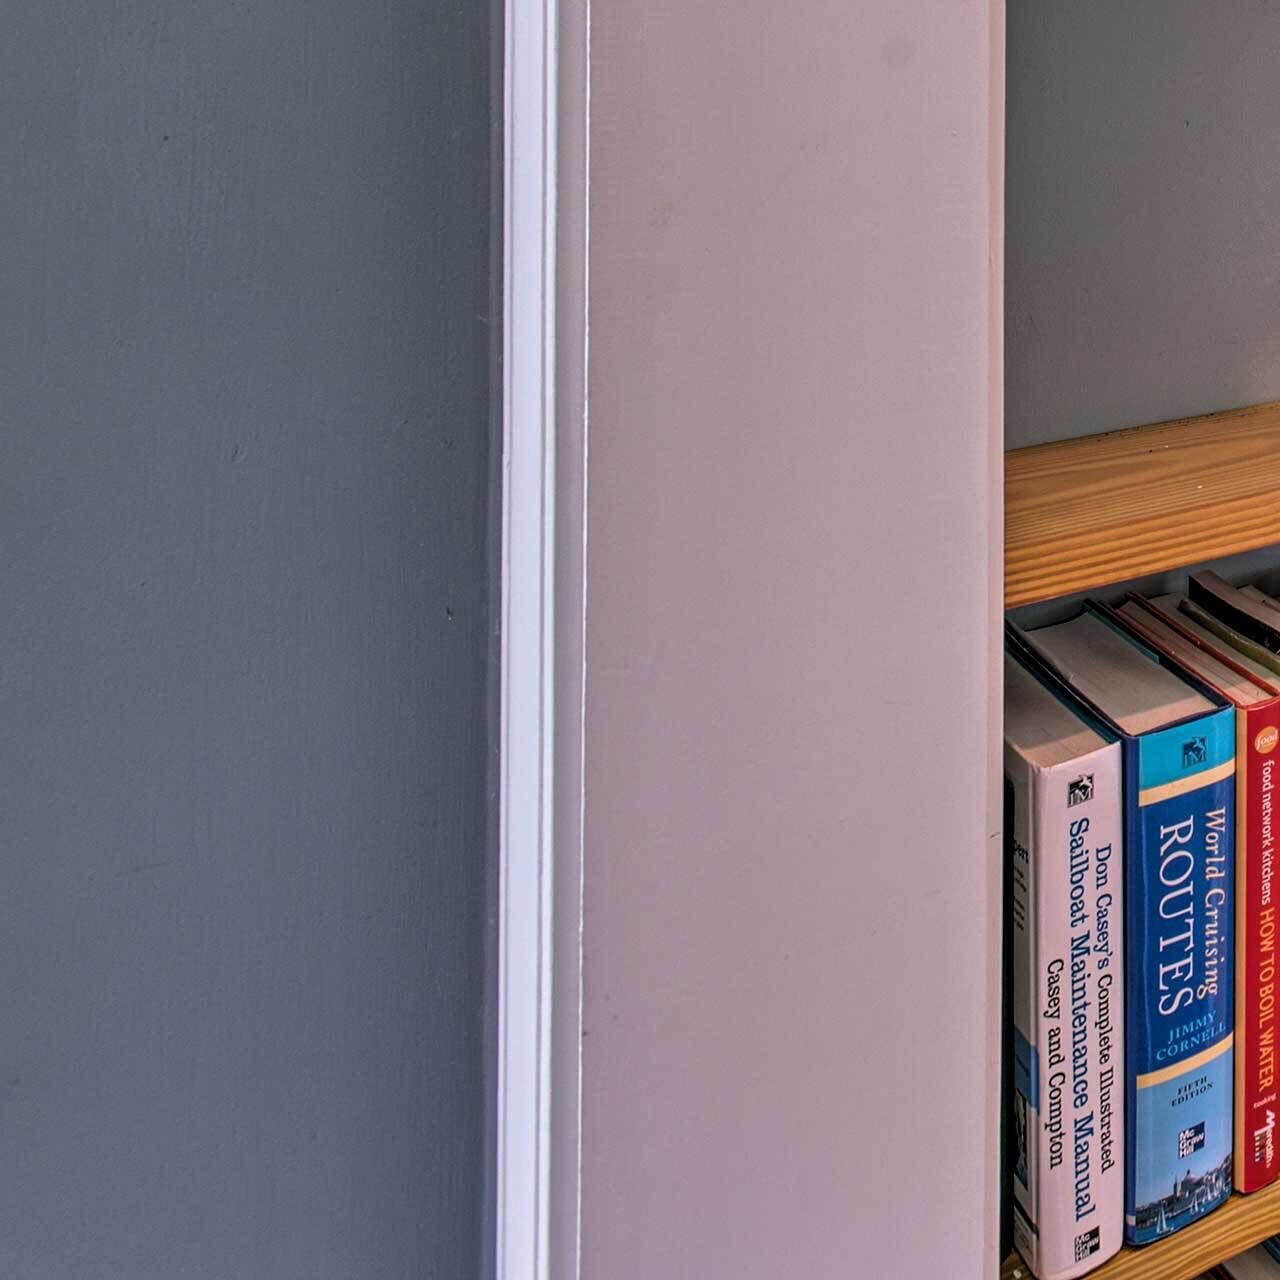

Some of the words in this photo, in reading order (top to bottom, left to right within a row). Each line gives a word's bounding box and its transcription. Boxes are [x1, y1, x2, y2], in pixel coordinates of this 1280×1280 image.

[1262, 760, 1275, 791] food
[1205, 806, 1226, 880] World
[1262, 792, 1274, 848] network
[1069, 818, 1090, 928] Sailboat
[1096, 843, 1112, 889] Don
[1262, 849, 1274, 905] kitchens
[1093, 893, 1112, 971] Casey's
[1159, 815, 1194, 1015] ROUTES
[1197, 888, 1226, 999] Cruising
[1260, 908, 1275, 952] HOW
[1043, 959, 1064, 1019] Casey
[1260, 953, 1274, 976] TO
[1070, 930, 1091, 1109] Maintenance
[1095, 974, 1113, 1065] Complete
[1168, 1010, 1217, 1044] JIMMY
[1260, 980, 1275, 1028] BOIL
[1047, 1026, 1066, 1069] and
[1156, 1022, 1227, 1061] CORNELL
[1259, 1030, 1274, 1092] WATER
[1171, 1082, 1214, 1107] EDITION
[1177, 1076, 1208, 1095] FIFTH
[1044, 1072, 1066, 1170] Compton
[1099, 1067, 1115, 1174] Illustrated
[1074, 1111, 1096, 1222] Manual
